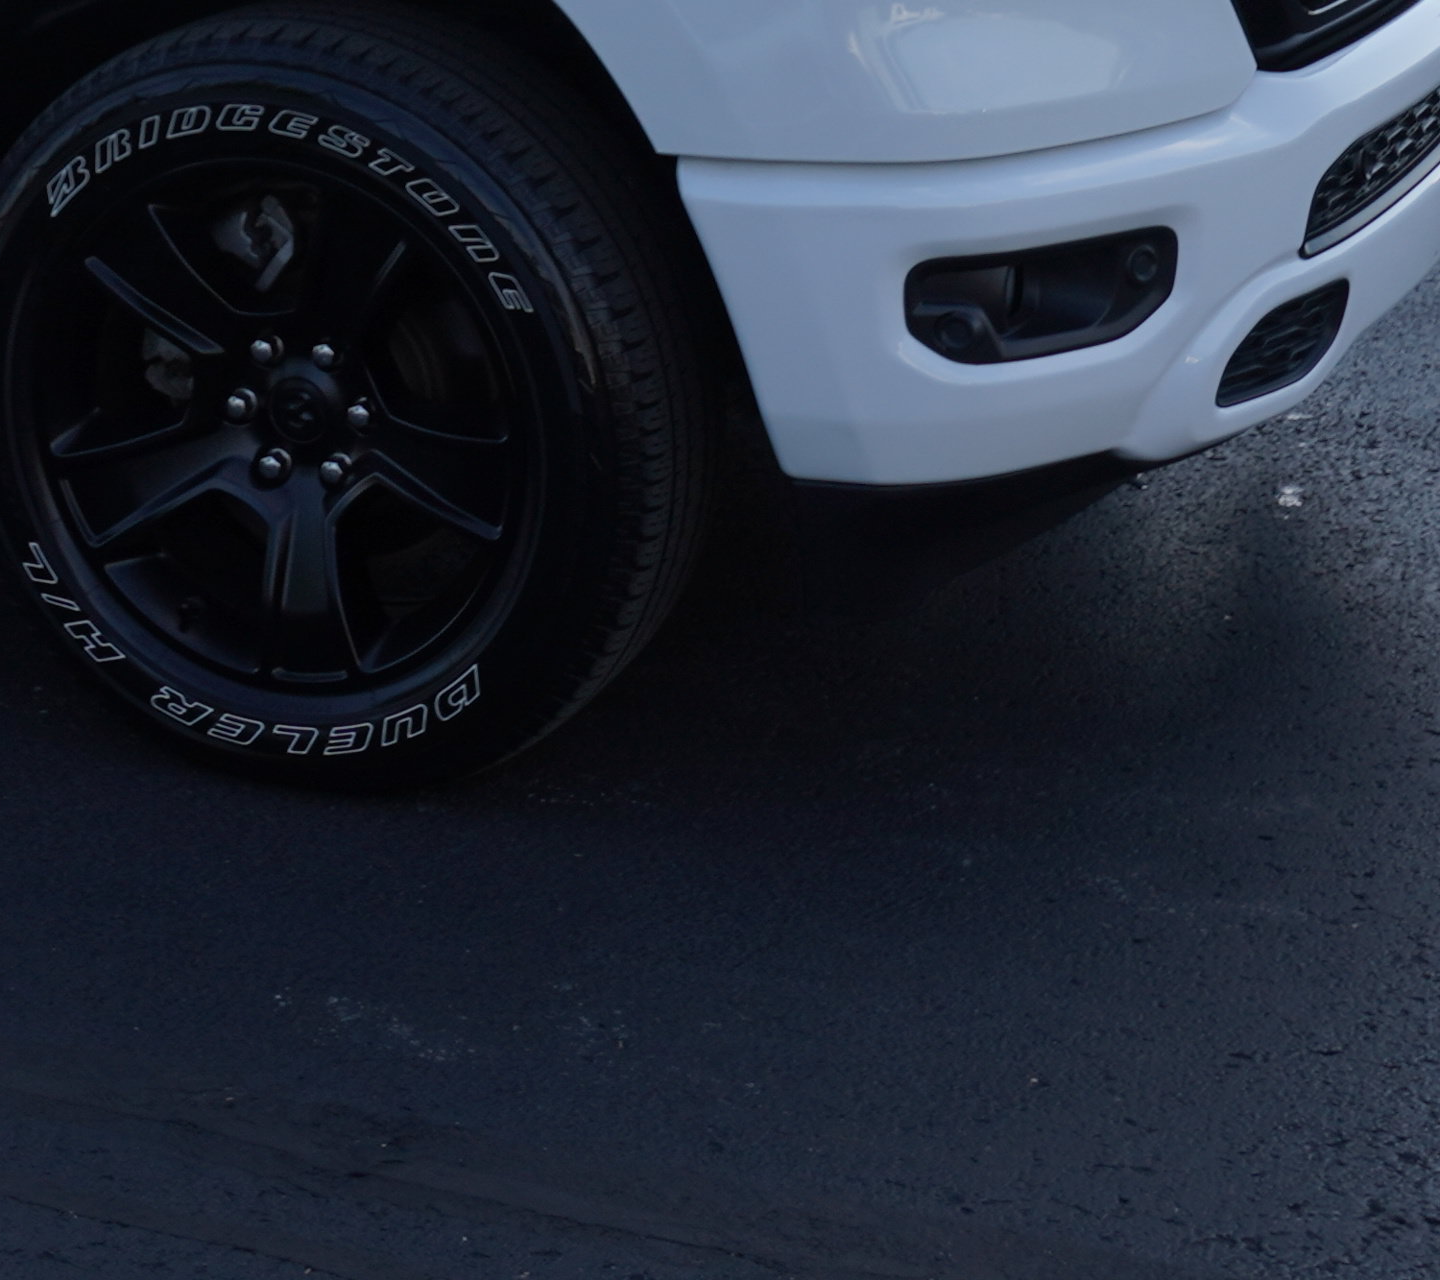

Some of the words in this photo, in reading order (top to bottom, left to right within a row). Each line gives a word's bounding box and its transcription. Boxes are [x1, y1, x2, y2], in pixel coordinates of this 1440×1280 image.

[45, 102, 535, 315] BRIDGESTONE
[22, 542, 125, 664] H/L
[150, 663, 481, 757] DUELER
